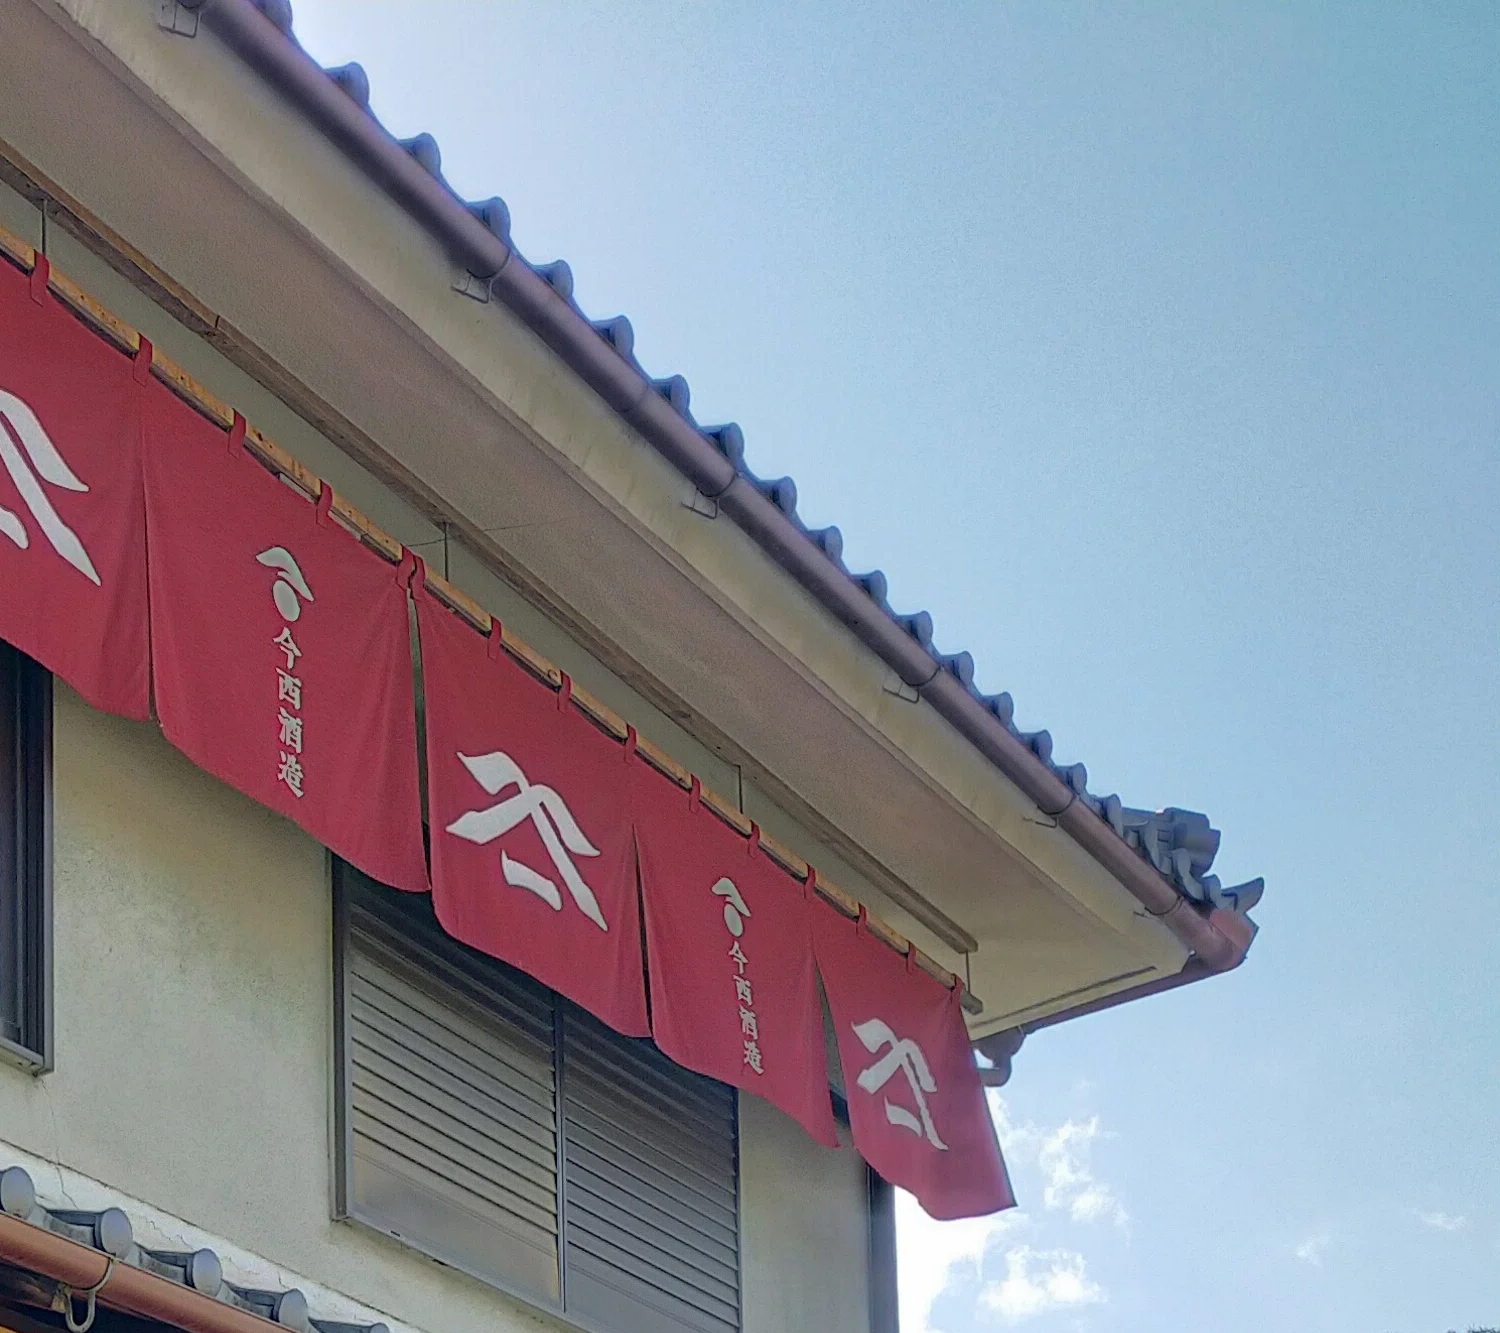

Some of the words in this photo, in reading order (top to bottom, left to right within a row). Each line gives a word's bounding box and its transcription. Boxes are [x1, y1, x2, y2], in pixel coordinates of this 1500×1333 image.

[273, 627, 305, 799] 今西酒造
[727, 941, 765, 1075] 今西酒造
